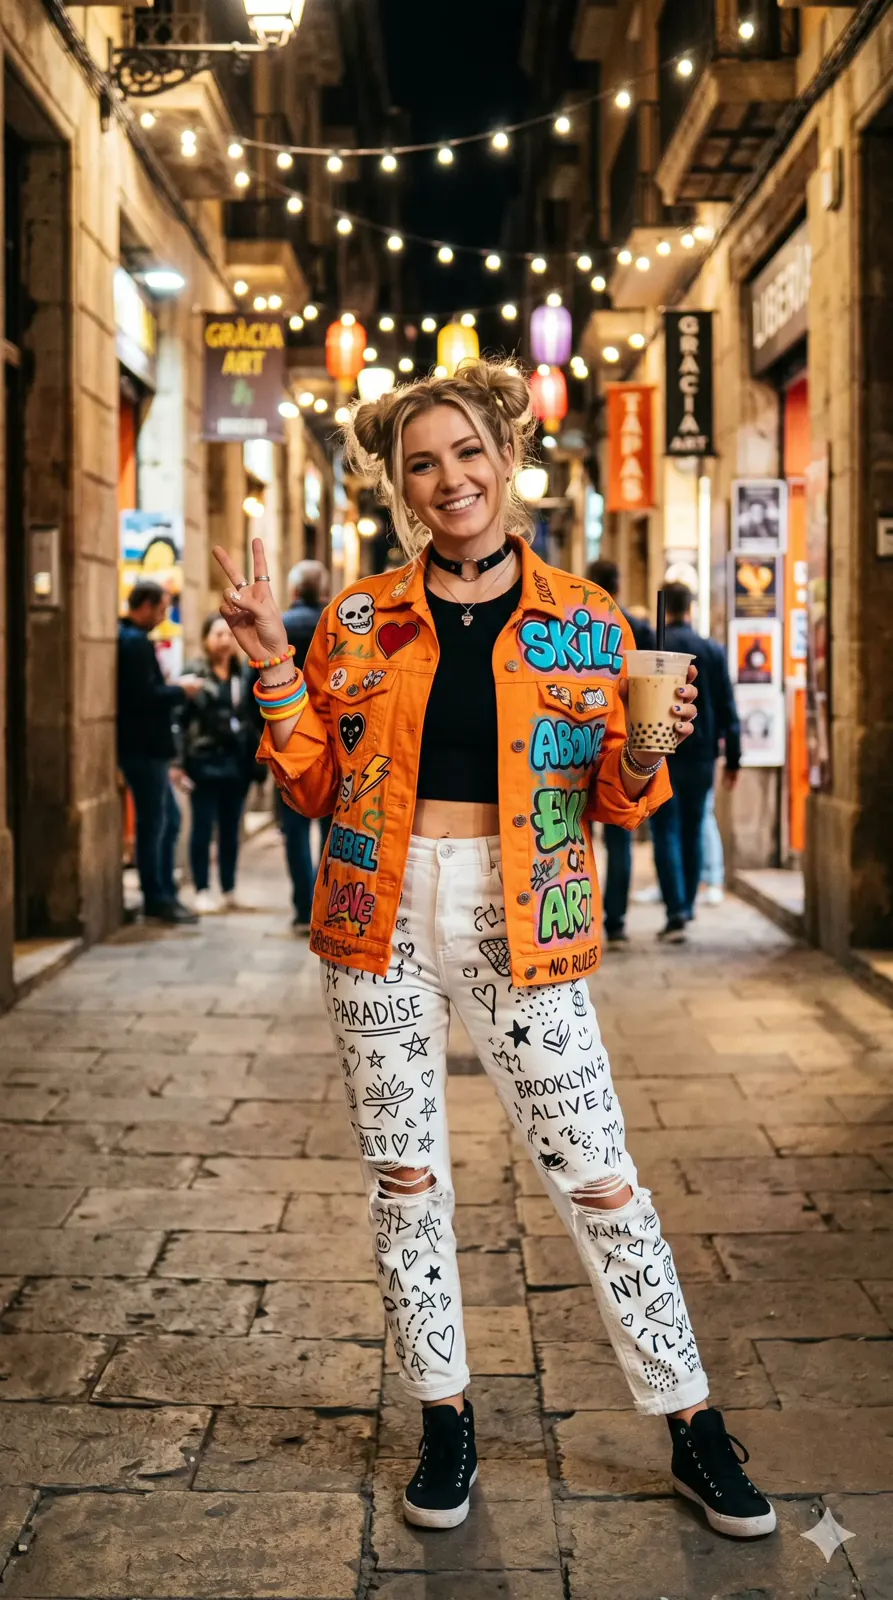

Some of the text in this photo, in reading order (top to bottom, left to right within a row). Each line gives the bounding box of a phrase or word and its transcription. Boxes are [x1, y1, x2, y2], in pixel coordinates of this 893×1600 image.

[221, 350, 267, 376] ART
[678, 315, 700, 434] GRACIA
[620, 391, 644, 502] TAPAS
[669, 435, 707, 452] ART
[328, 822, 378, 872] REBEL
[328, 879, 375, 924] LOVE
[549, 945, 598, 978] NO RULES
[514, 1061, 597, 1099] BROOKLYN
[532, 1090, 599, 1121] ALIVE
[610, 1264, 660, 1304] NYC
